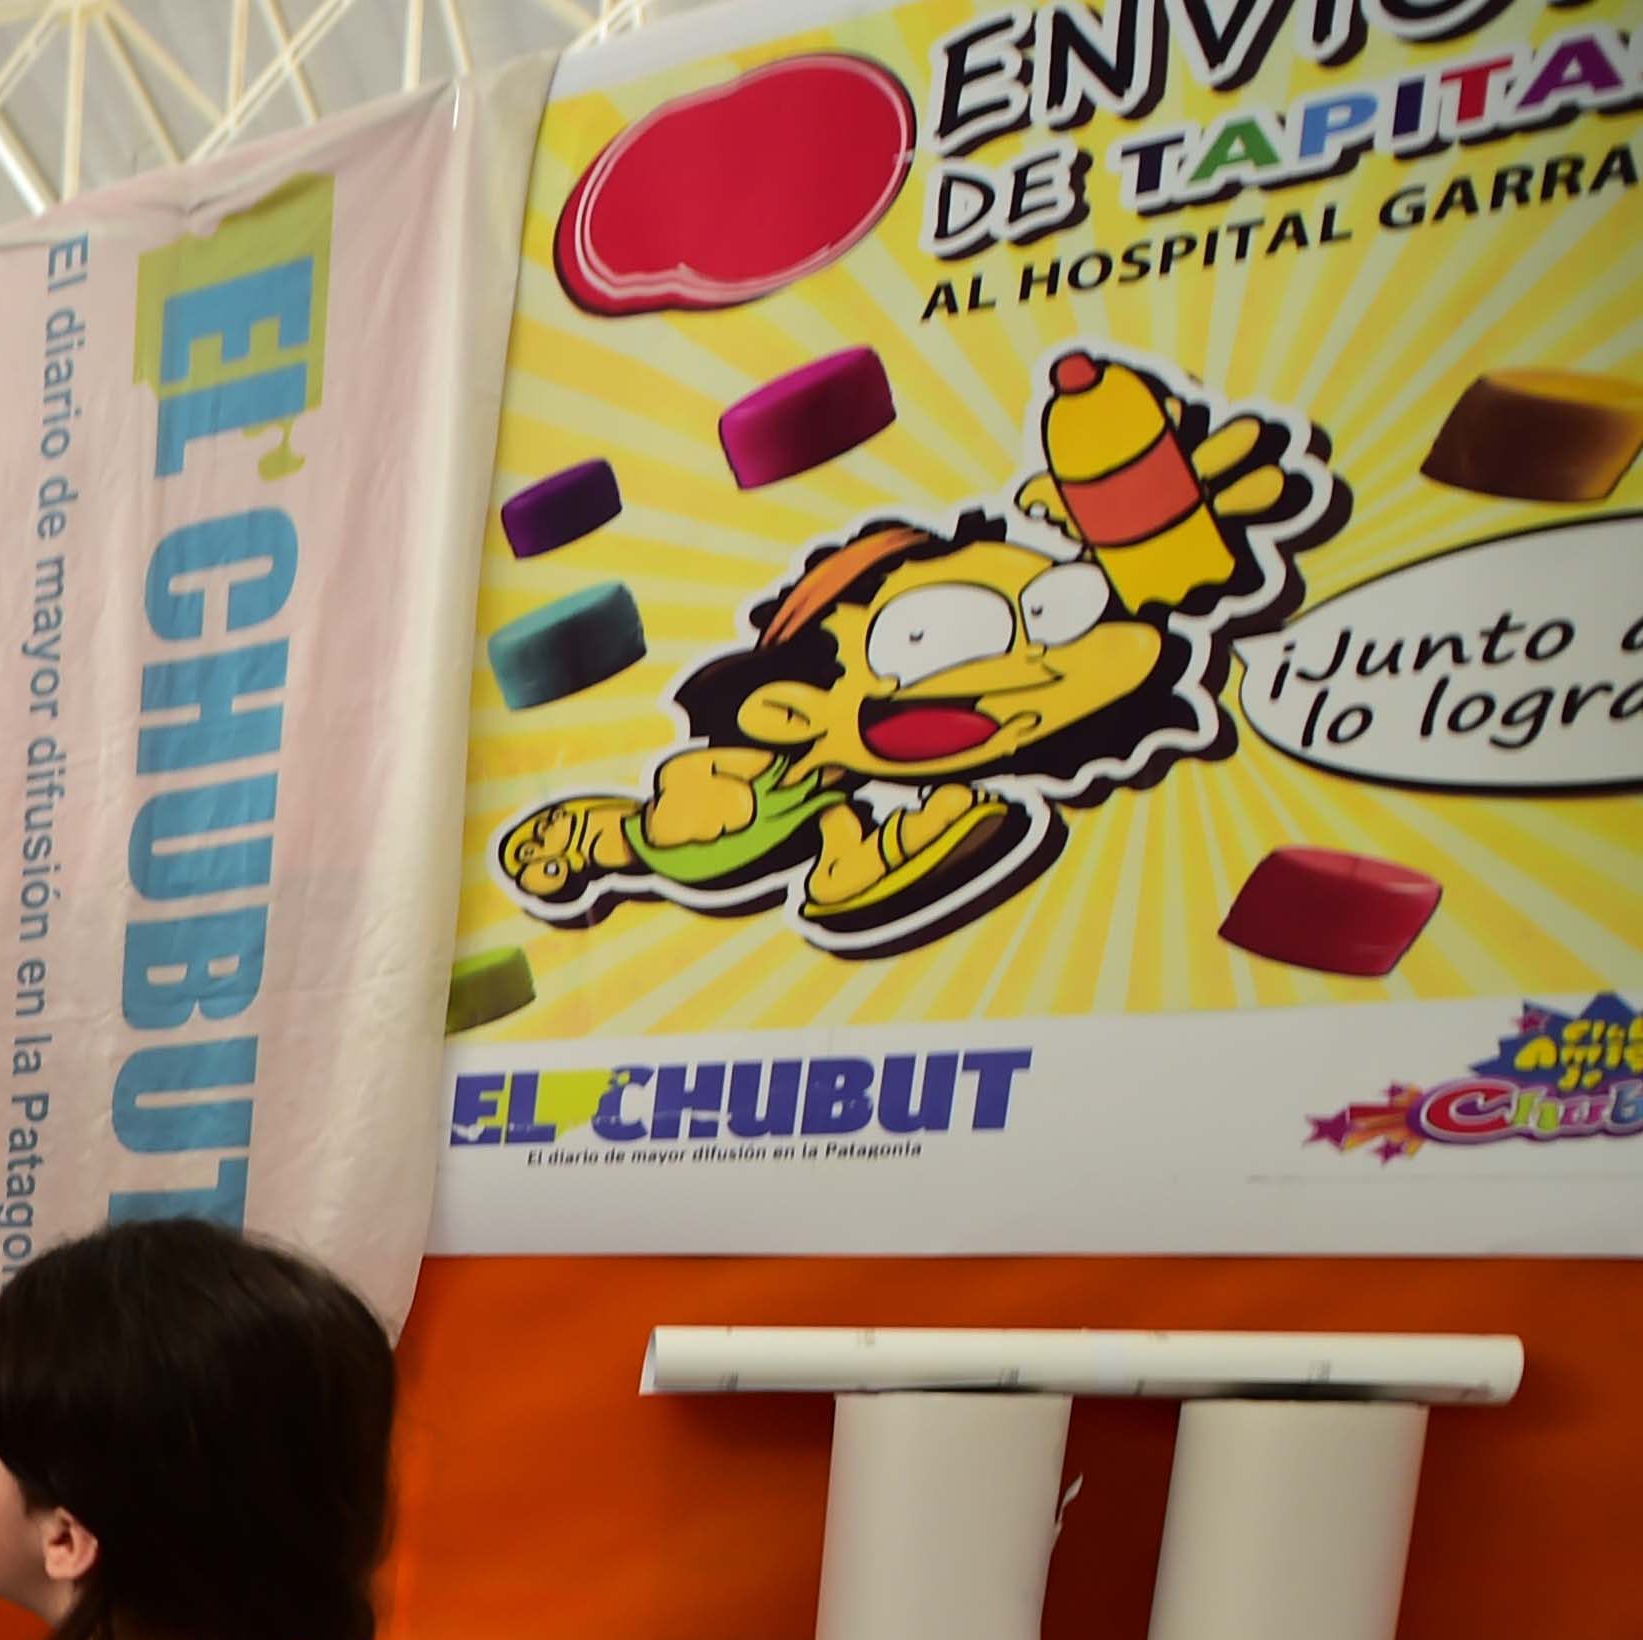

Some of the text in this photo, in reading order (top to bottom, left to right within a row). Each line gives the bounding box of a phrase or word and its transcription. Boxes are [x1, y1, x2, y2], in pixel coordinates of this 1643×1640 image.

[934, 34, 1643, 241] DE TAPITA
[47, 231, 89, 293] El
[921, 144, 1640, 322] AL HOSPITAL GARRA
[40, 307, 86, 460] diario
[36, 476, 79, 541] de
[21, 555, 66, 720] mayor
[108, 255, 314, 1234] EL CHUBUT
[1301, 688, 1374, 748] lo
[18, 736, 67, 944] difusión
[15, 957, 47, 1017] en
[12, 1033, 53, 1077] la
[450, 1047, 1033, 1147] EL CHUBUT
[527, 1141, 922, 1166] El diario de mayor difusión en la Patagonia
